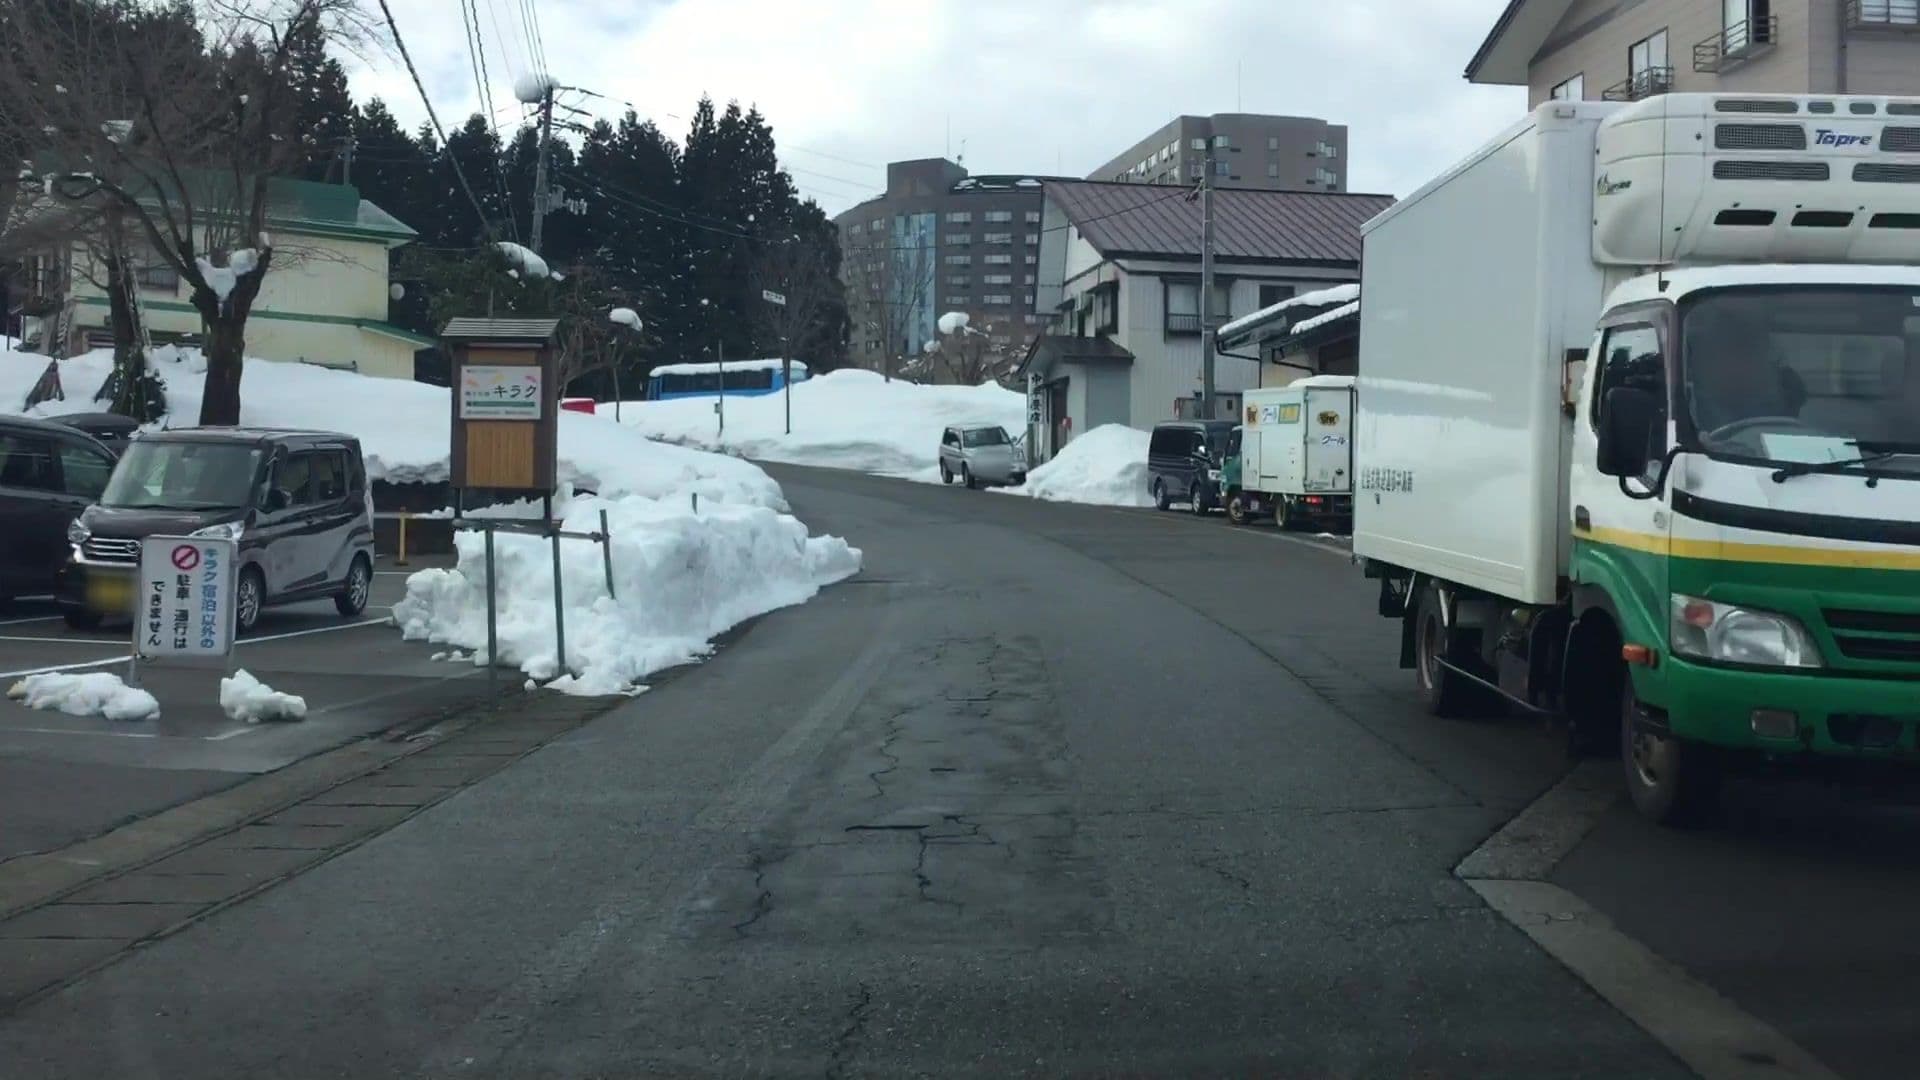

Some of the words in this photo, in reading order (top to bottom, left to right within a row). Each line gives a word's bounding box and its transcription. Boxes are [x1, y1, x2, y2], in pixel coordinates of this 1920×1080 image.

[493, 384, 537, 398] キラク
[147, 580, 166, 647] できません
